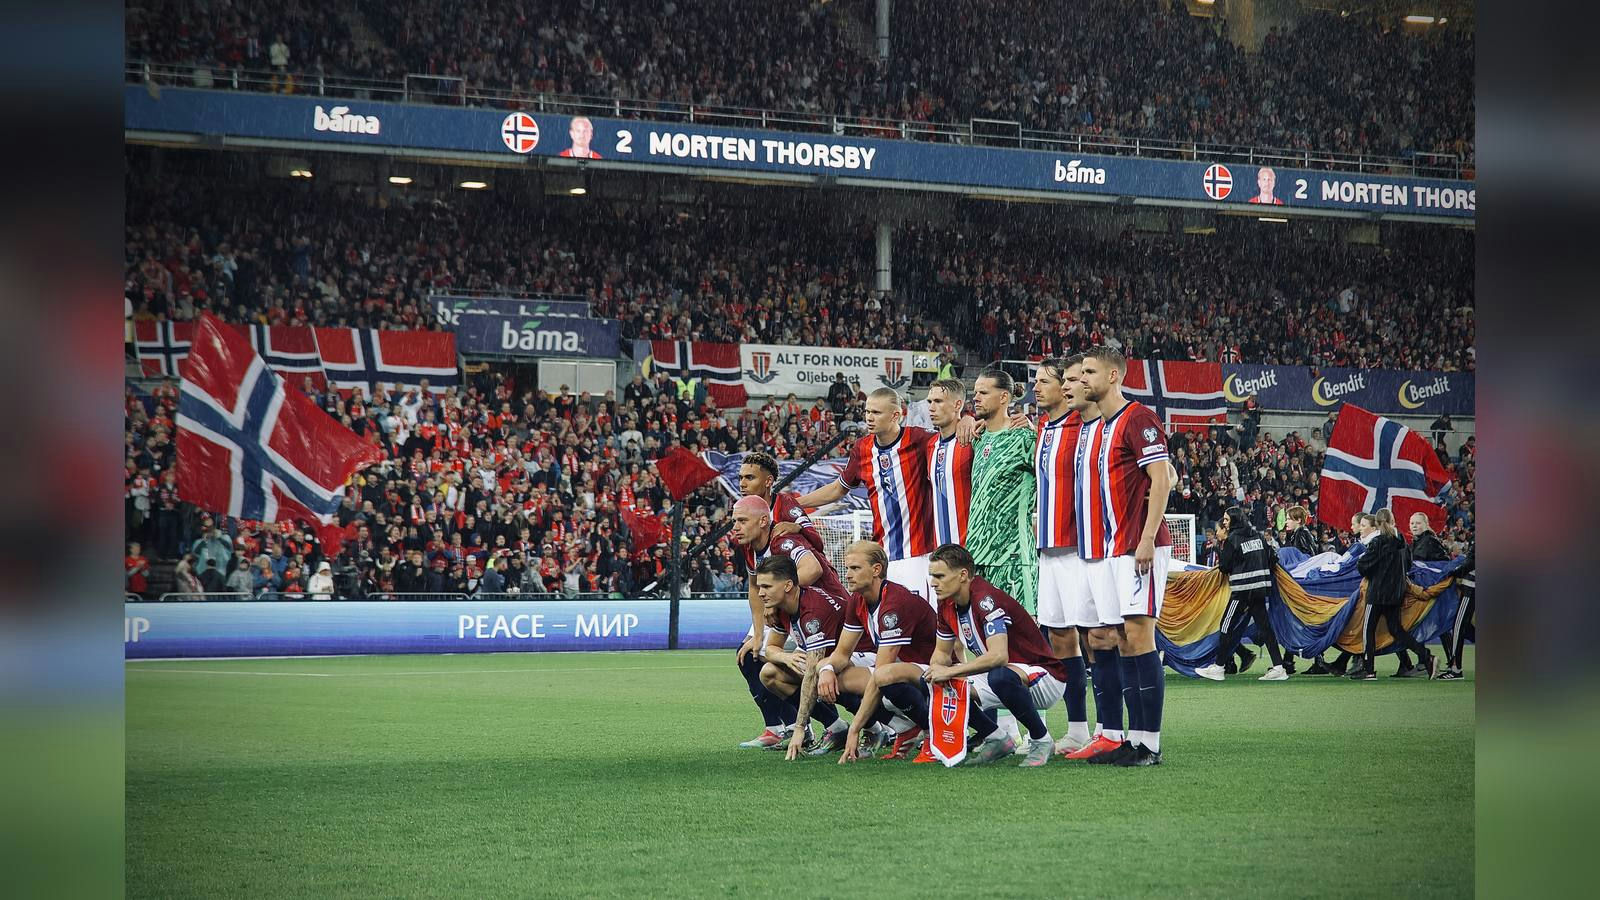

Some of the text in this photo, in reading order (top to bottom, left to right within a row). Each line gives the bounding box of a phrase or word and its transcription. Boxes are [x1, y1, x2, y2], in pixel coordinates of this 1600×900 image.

[615, 130, 876, 170] 2 MORTEN THORSBY
[1294, 178, 1308, 200] 2
[1321, 180, 1408, 206] MORTEN
[501, 320, 579, 352] bama
[776, 352, 879, 368] ALT FOR NORGE
[796, 370, 861, 385] Oljebeet
[1234, 369, 1278, 396] Bendit
[1323, 373, 1366, 399] Bendit
[1409, 376, 1451, 402] Bendit
[458, 614, 546, 639] PEACE
[575, 613, 639, 637] МИР
[986, 621, 996, 636] C
